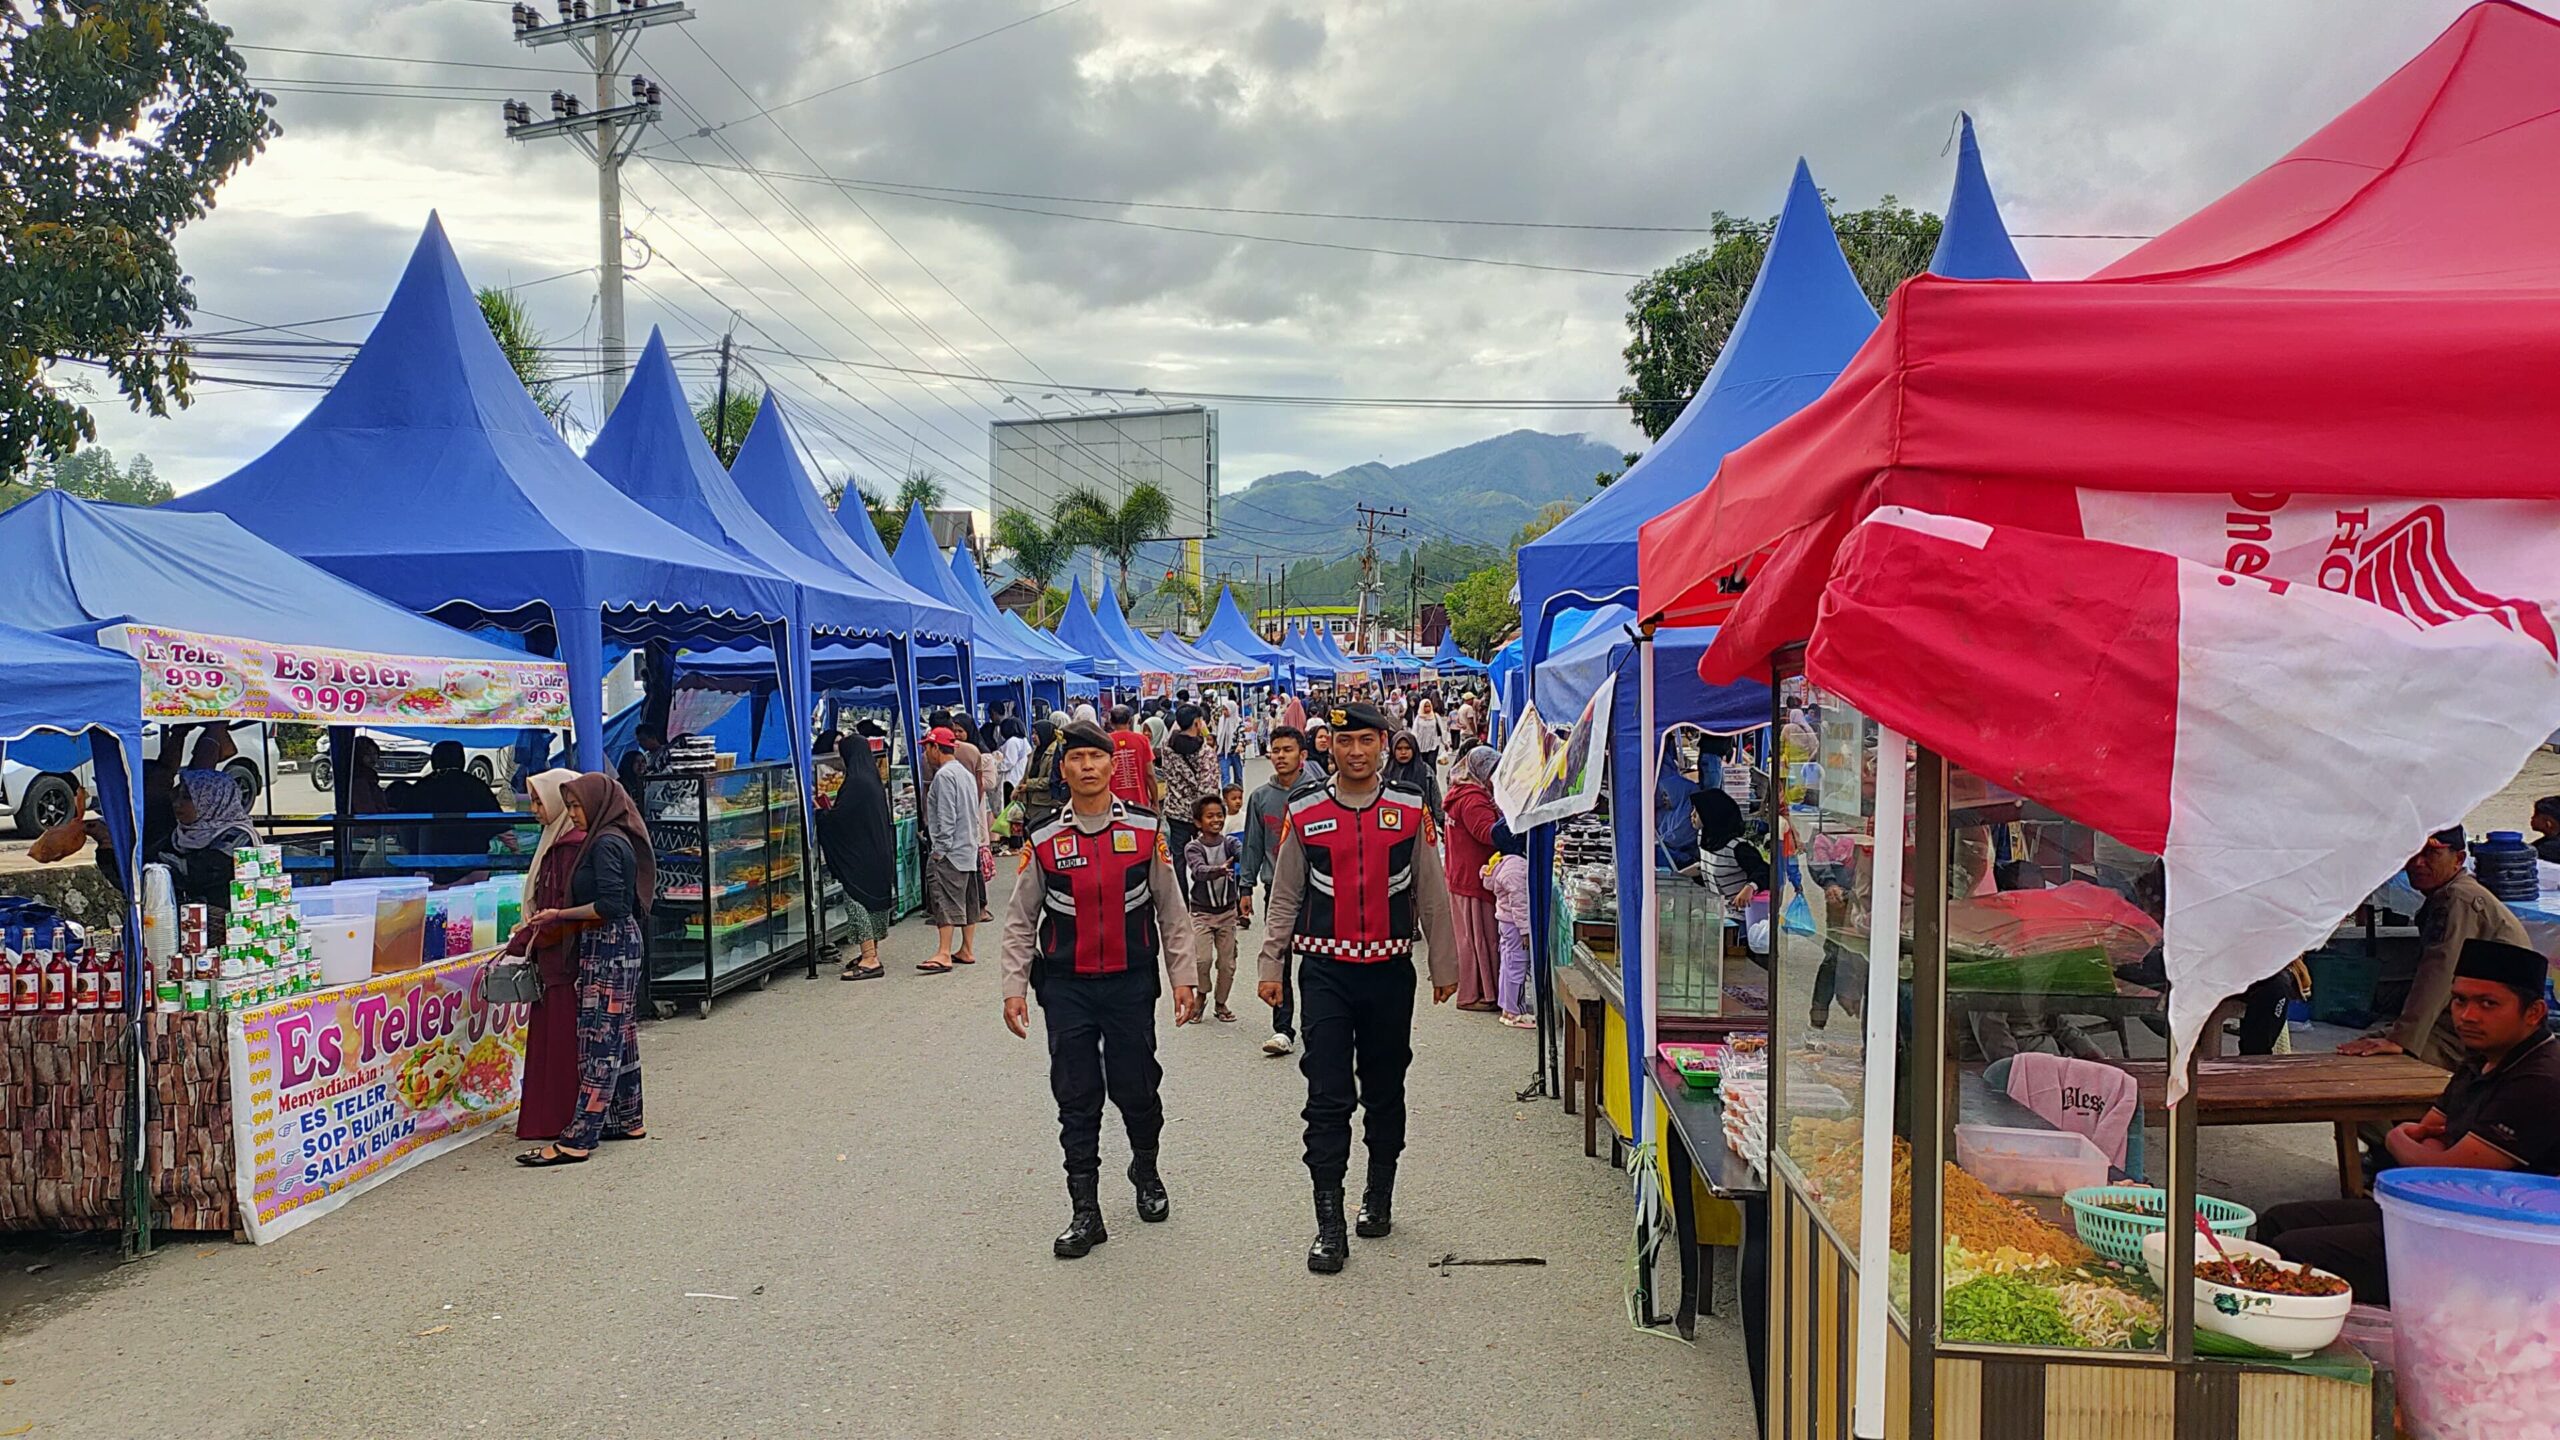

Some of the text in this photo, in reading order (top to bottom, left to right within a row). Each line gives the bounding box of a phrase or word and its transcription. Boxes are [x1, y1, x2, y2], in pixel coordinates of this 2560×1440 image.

[144, 642, 168, 660] Es
[169, 644, 226, 664] Teler
[271, 651, 317, 680] Es
[322, 657, 411, 687] Teler
[165, 668, 225, 688] 999
[518, 672, 536, 686] Es
[535, 673, 563, 688] Teler
[290, 685, 366, 714] 999
[527, 690, 565, 705] 999
[344, 986, 362, 999] 999
[276, 1013, 342, 1090] Es
[354, 986, 463, 1063] Teler
[278, 1067, 378, 1115] Menyadiankan
[299, 1083, 387, 1134] ES TELER
[302, 1103, 395, 1159] SOP BUAH
[303, 1117, 416, 1184] SALAK BUAH
